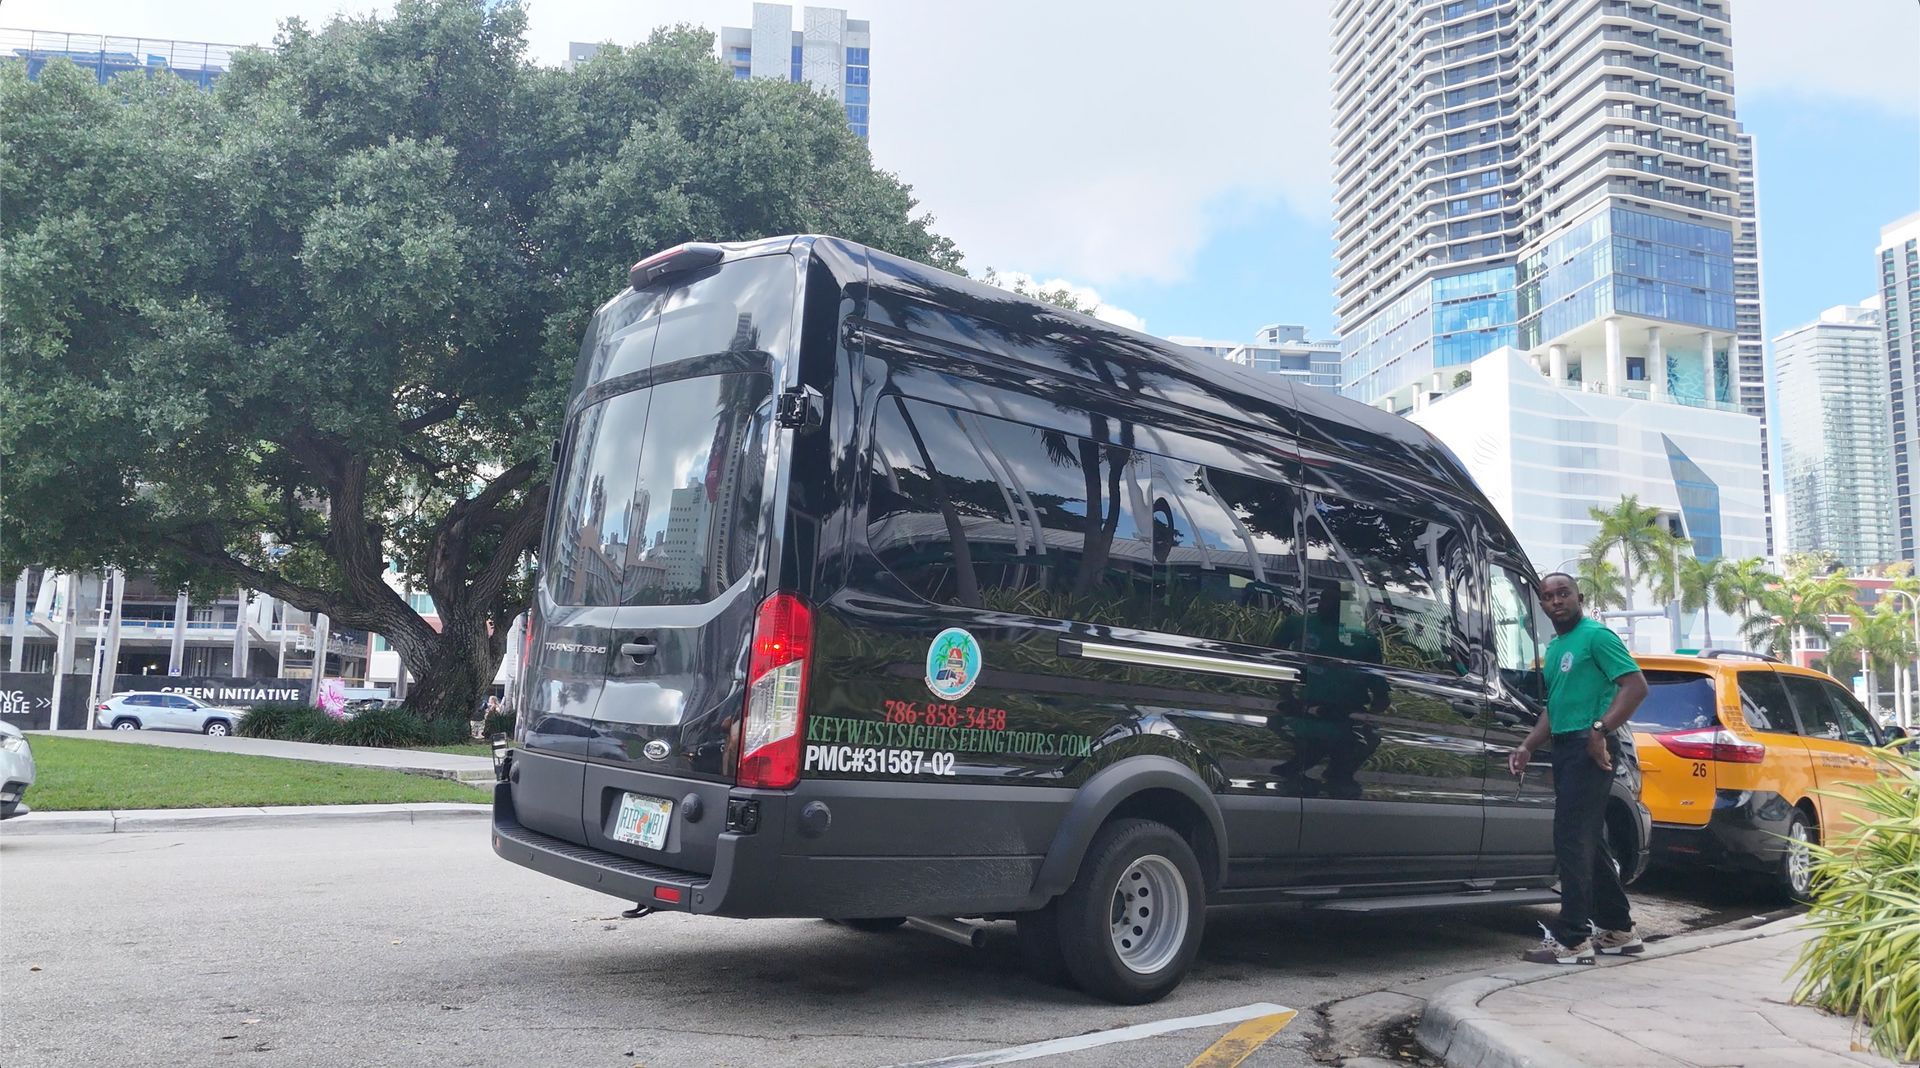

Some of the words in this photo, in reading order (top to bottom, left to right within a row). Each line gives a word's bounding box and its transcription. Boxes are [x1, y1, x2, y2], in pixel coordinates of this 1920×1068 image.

[545, 642, 583, 653] TRANSIT
[583, 645, 607, 655] 350HD
[219, 688, 299, 700] INITIATIVE
[0, 701, 30, 714] BLE
[885, 700, 1007, 731] 786-858-3458
[807, 714, 1092, 758] KEYWESTSIGHTSEEINGTOURS.COM
[804, 745, 956, 776] PMC#31587-02
[1692, 763, 1707, 778] 26
